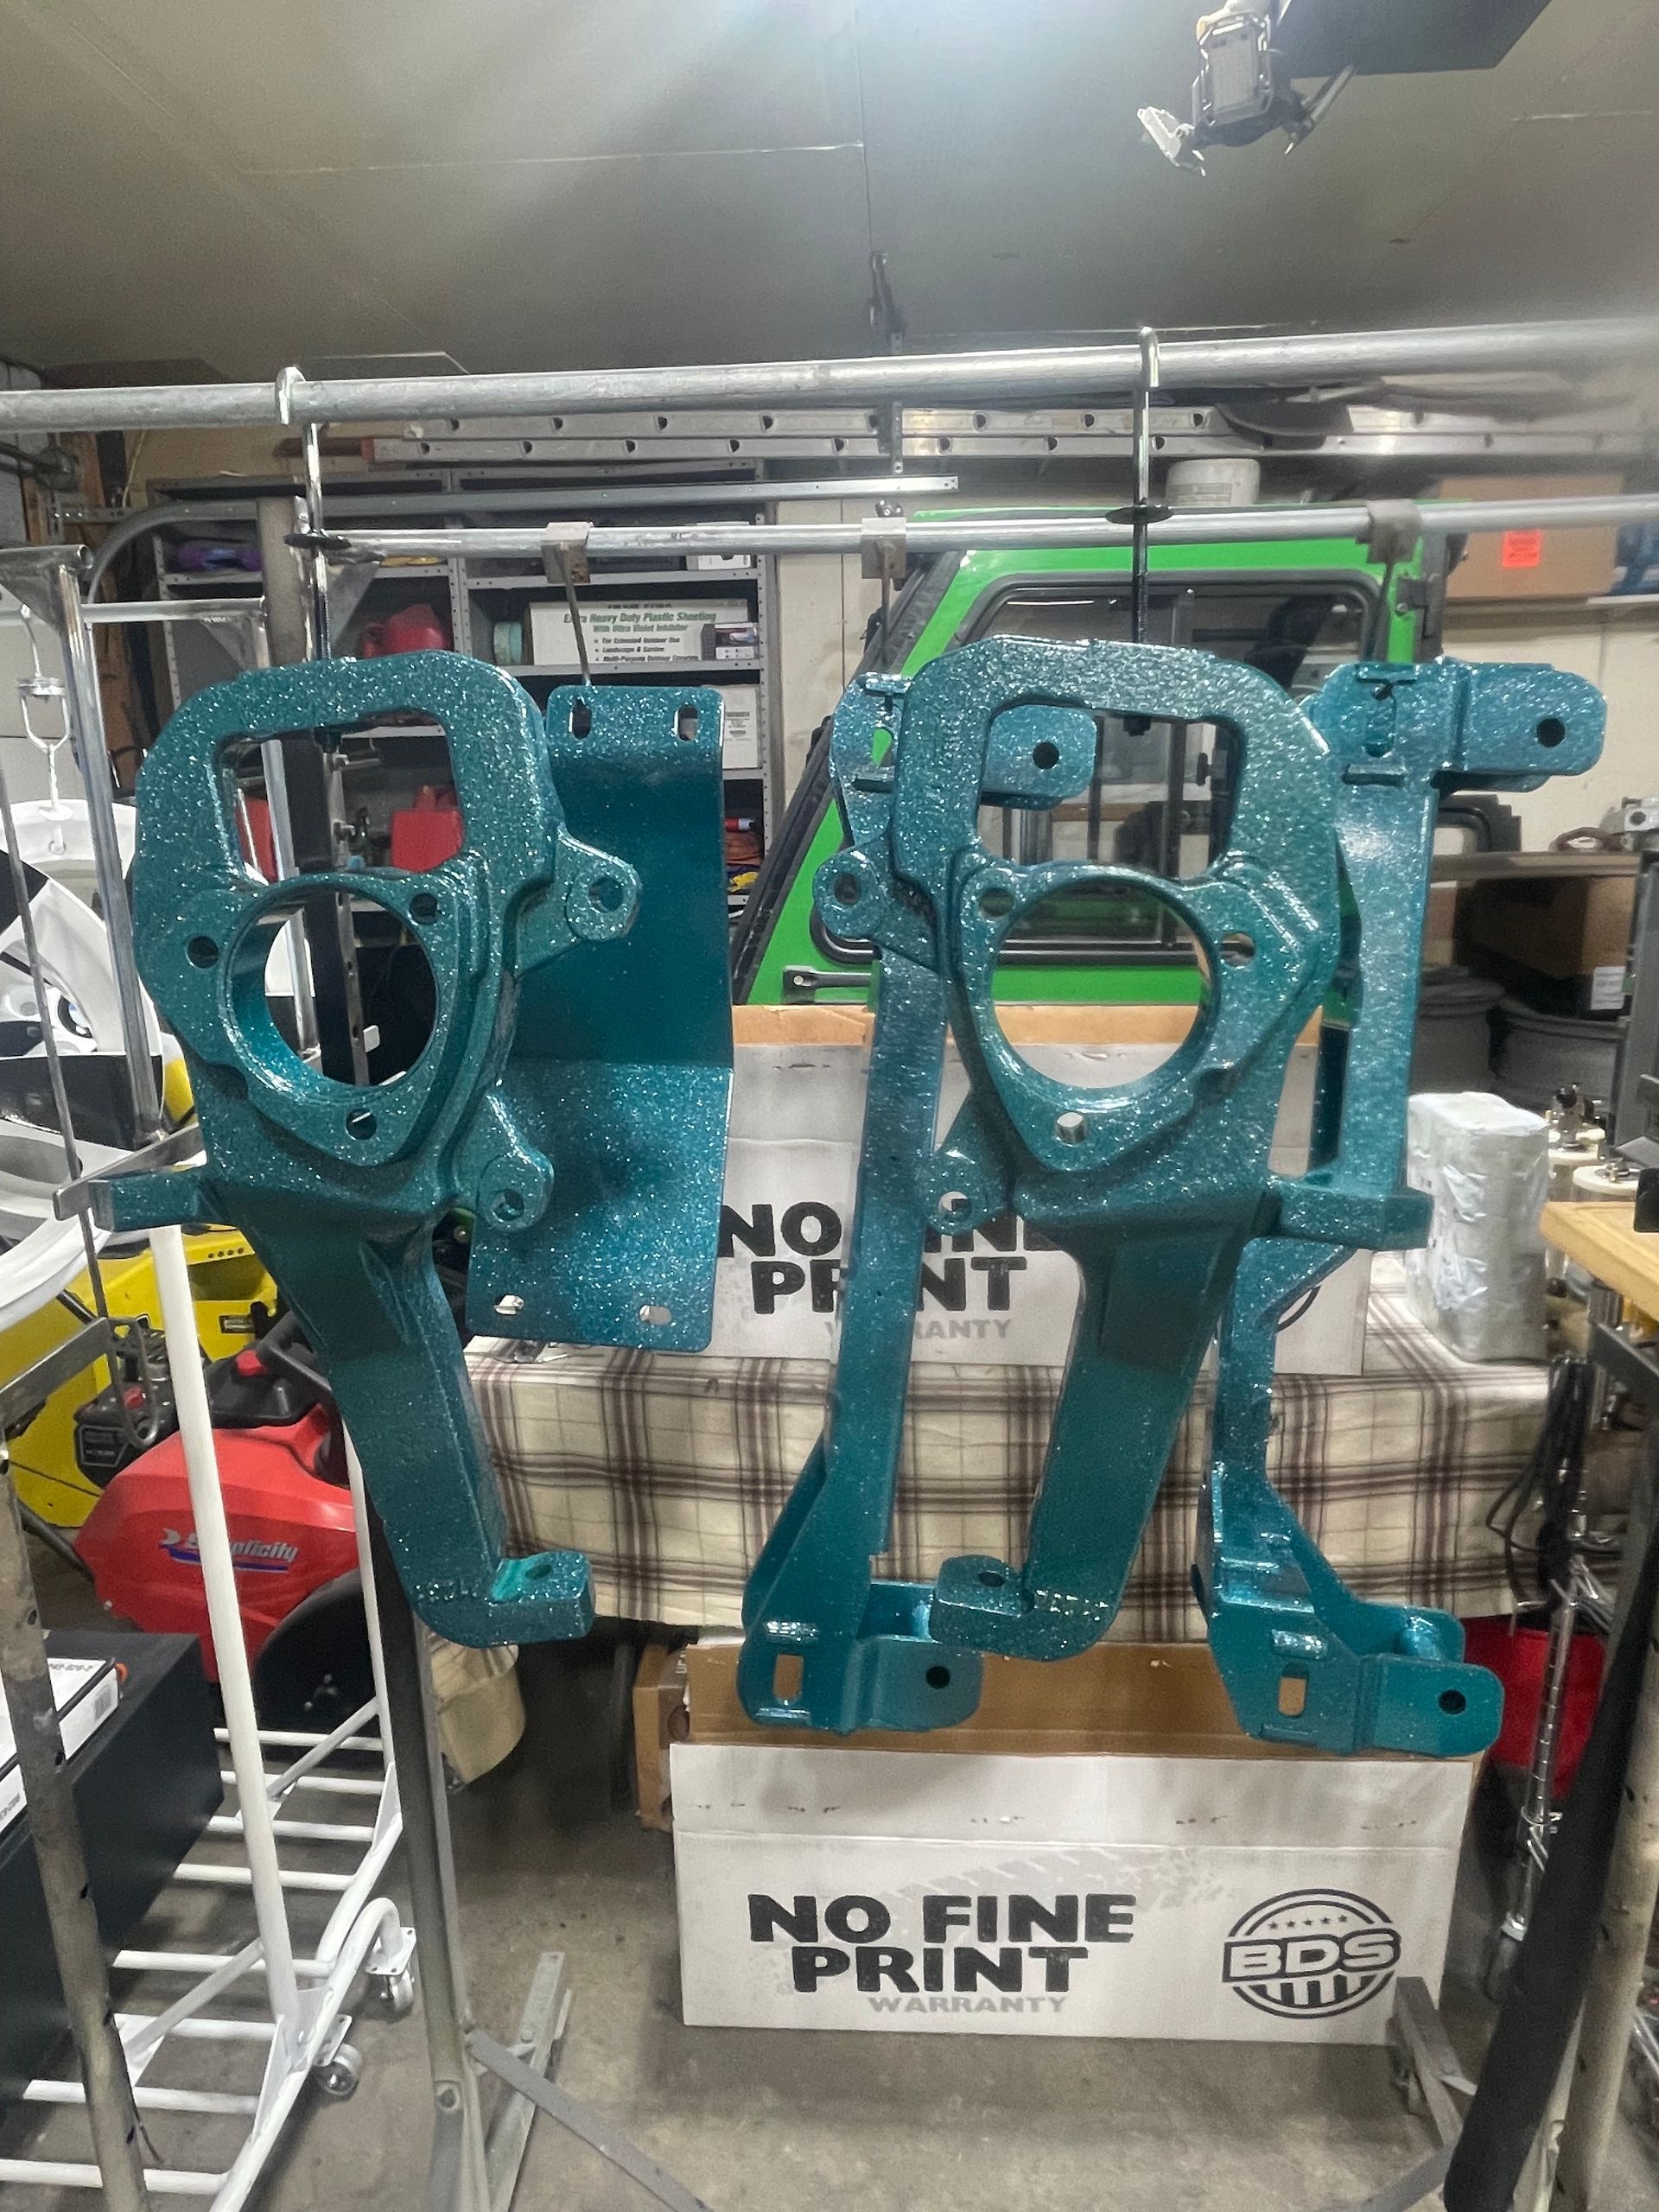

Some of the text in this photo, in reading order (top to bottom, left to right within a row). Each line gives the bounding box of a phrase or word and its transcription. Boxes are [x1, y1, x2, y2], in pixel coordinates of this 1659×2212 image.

[589, 613, 617, 624] Heavy
[620, 612, 641, 623] Duty
[643, 612, 674, 622] Plastic
[718, 1201, 842, 1257] NO
[185, 1532, 298, 1563] Splicity
[747, 1893, 1137, 1944] NO FINE
[791, 1946, 1089, 1993] PRINT
[1222, 1927, 1402, 1983] BDS
[868, 1996, 1066, 2013] WARRANTY
